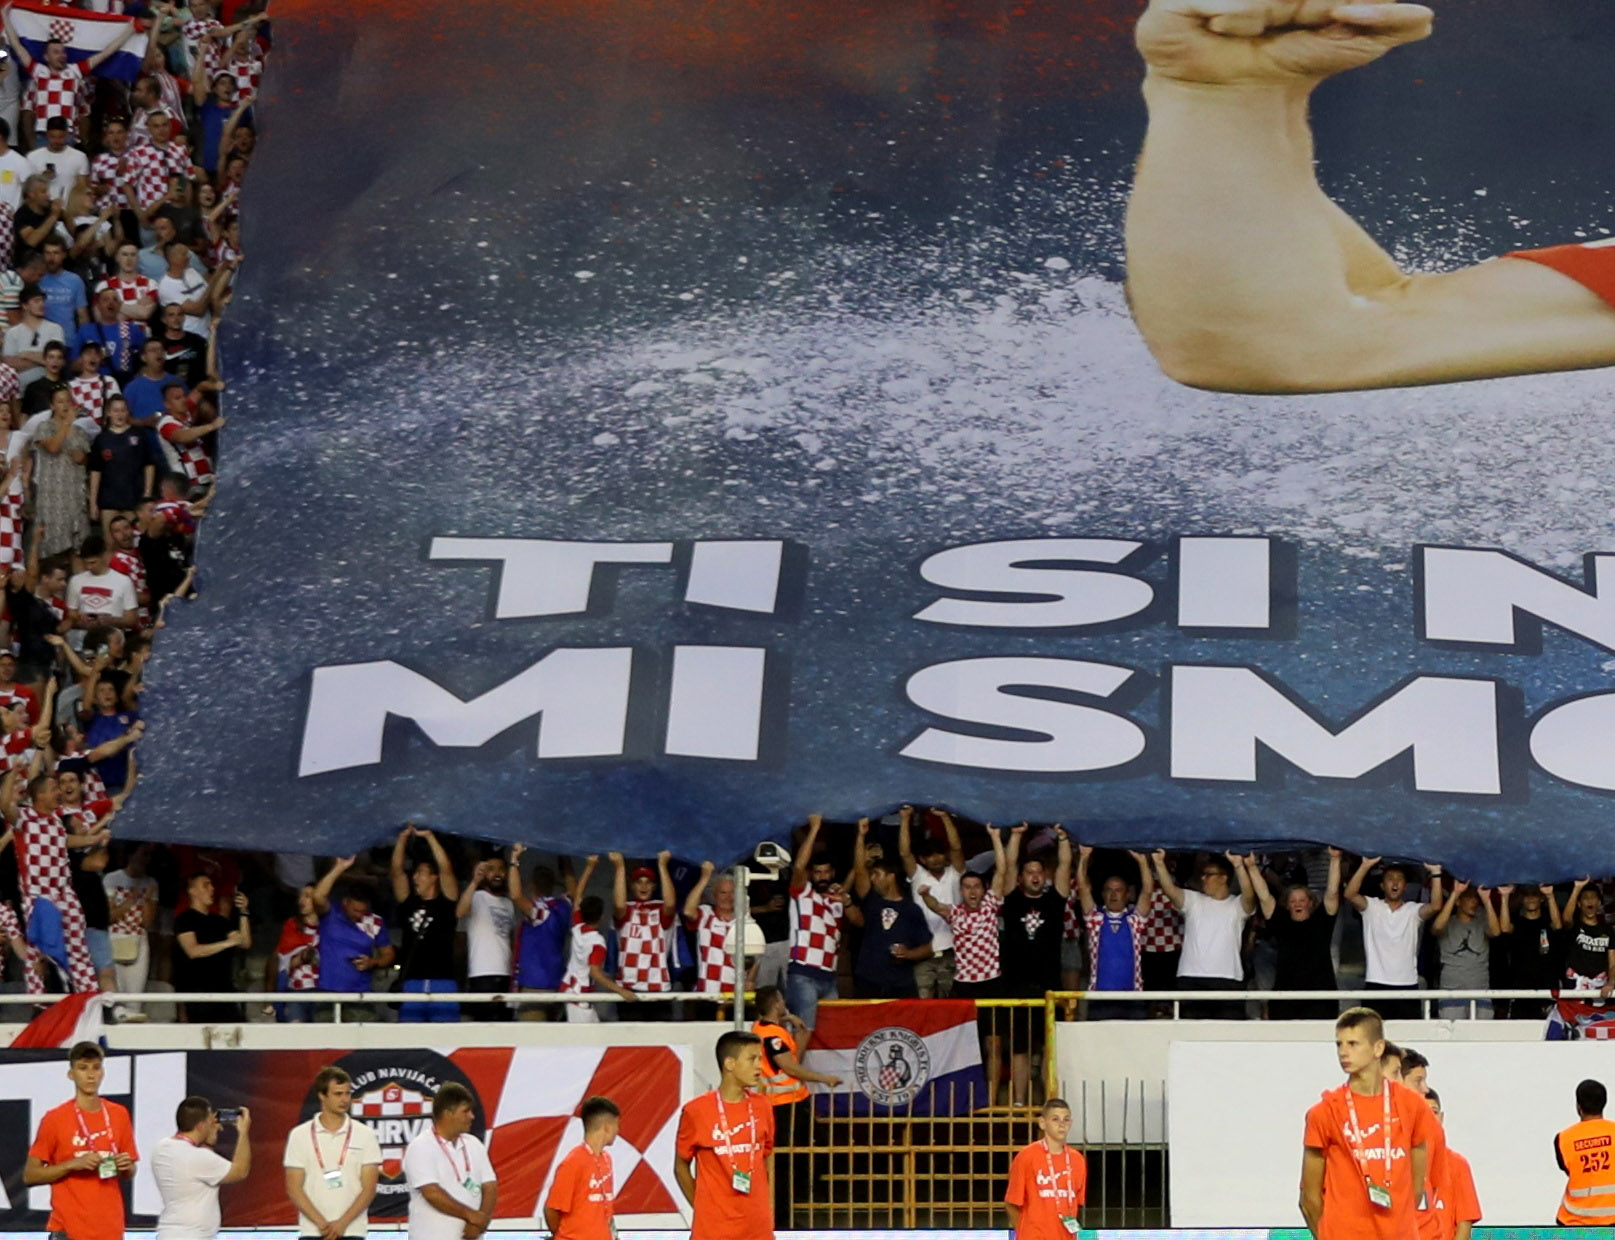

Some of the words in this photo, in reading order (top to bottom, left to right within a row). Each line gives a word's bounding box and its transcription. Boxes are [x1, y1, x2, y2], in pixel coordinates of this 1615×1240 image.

[430, 536, 783, 619] TI
[913, 537, 1271, 630] SI
[299, 646, 766, 777] MI
[1575, 1137, 1611, 1150] SECURITY
[1580, 1151, 1610, 1173] 252
